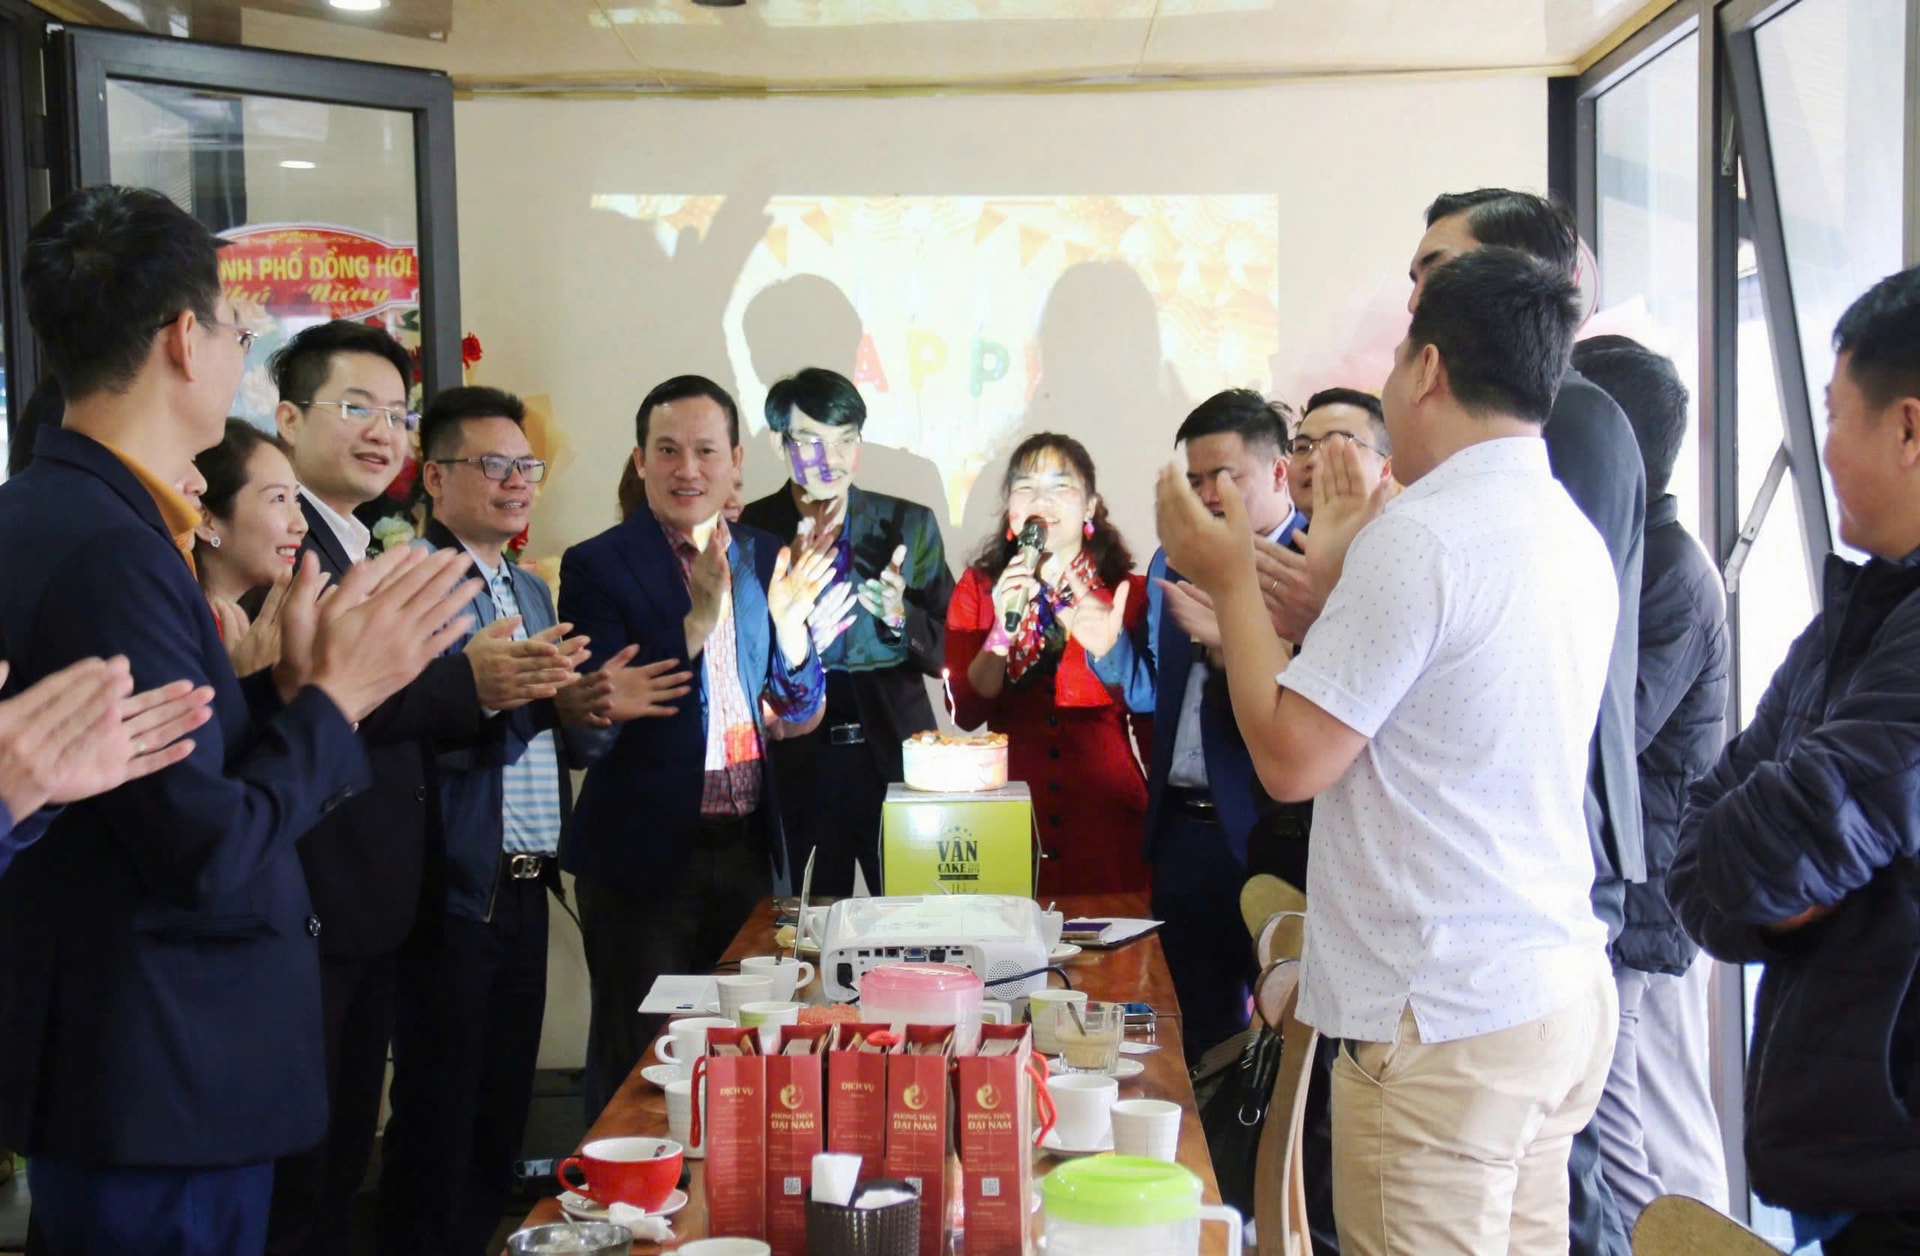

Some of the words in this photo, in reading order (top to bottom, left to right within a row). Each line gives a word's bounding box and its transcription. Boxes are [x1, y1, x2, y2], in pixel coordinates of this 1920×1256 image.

[259, 246, 303, 281] PHỐ
[376, 250, 412, 278] HỚI
[936, 836, 979, 862] VÂN
[937, 863, 967, 873] CAKE
[771, 1112, 795, 1120] PHONG
[893, 1113, 917, 1121] PHONG
[967, 1112, 992, 1121] PHONG
[791, 1120, 815, 1130] NAM
[913, 1121, 937, 1131] NAM
[988, 1121, 1012, 1130] NAM
